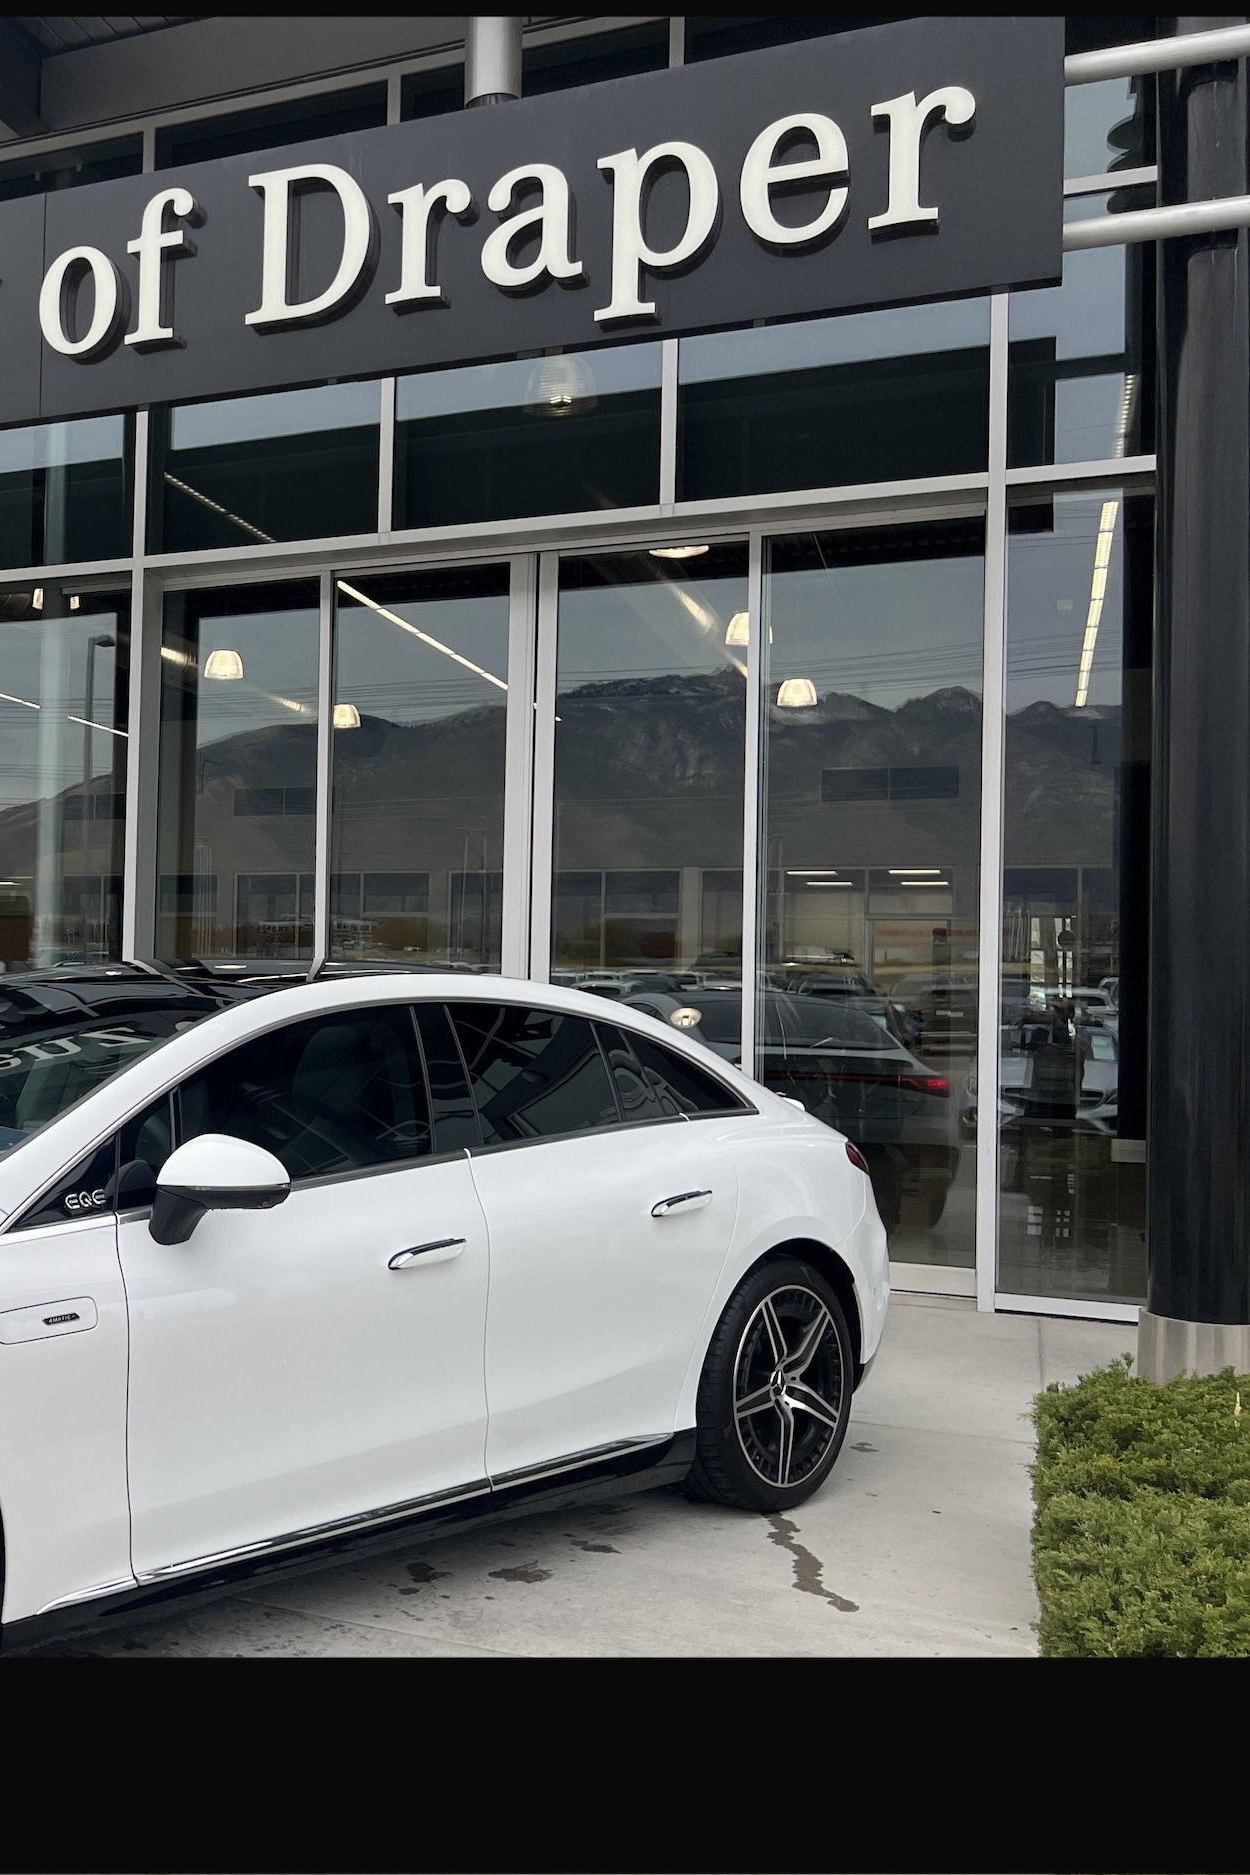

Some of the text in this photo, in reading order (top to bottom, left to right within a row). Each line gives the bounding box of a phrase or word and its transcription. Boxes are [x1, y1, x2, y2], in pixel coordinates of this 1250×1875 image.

[39, 187, 195, 356] of
[245, 85, 977, 325] Draper
[65, 1188, 106, 1209] EQE
